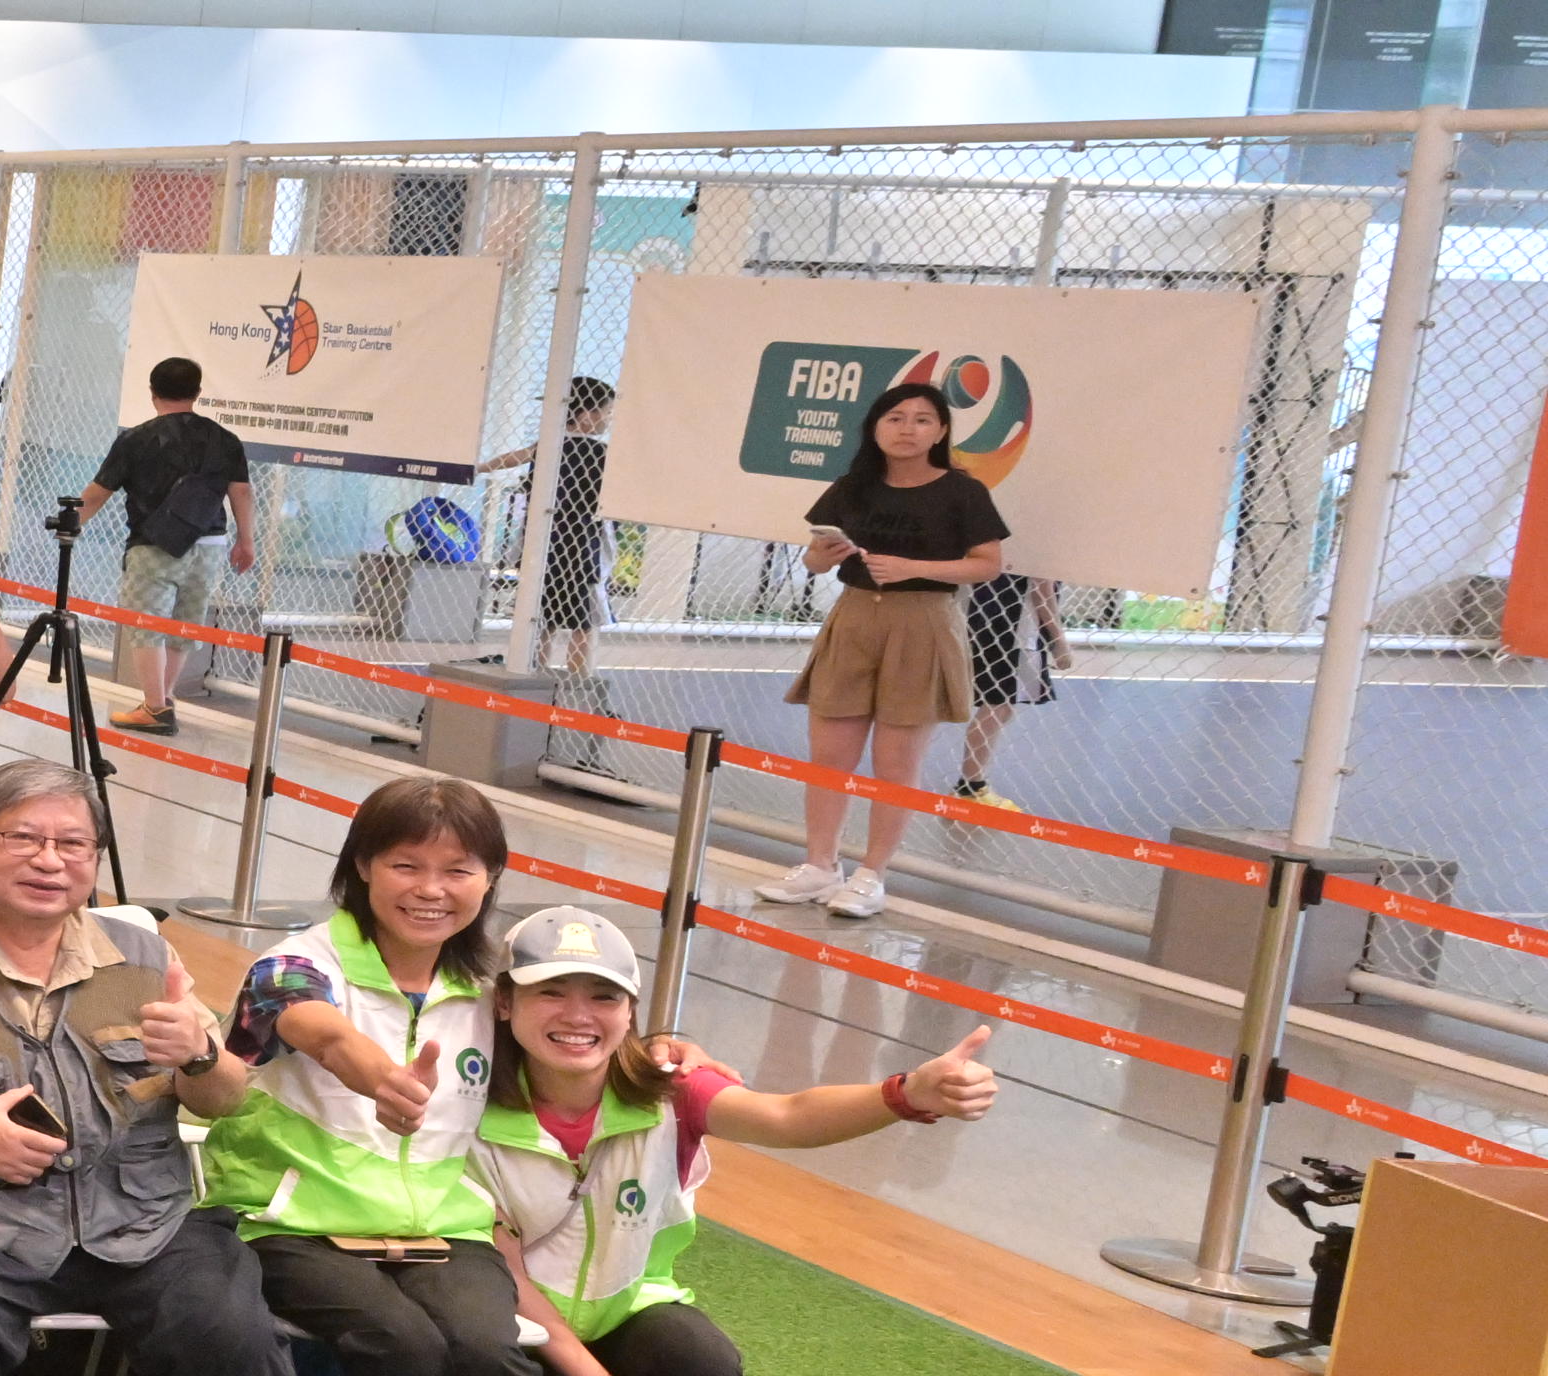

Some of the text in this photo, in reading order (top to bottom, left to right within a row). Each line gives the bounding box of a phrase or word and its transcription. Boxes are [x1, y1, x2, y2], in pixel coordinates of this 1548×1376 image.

[209, 322, 392, 342] Hong Kong Star Basketball
[322, 337, 392, 351] Training Centre
[787, 359, 862, 402] FIBA
[797, 409, 839, 427] YOUTH
[784, 426, 843, 448] TRAINING
[790, 450, 825, 466] CHINA
[1328, 1191, 1361, 1205] RON
